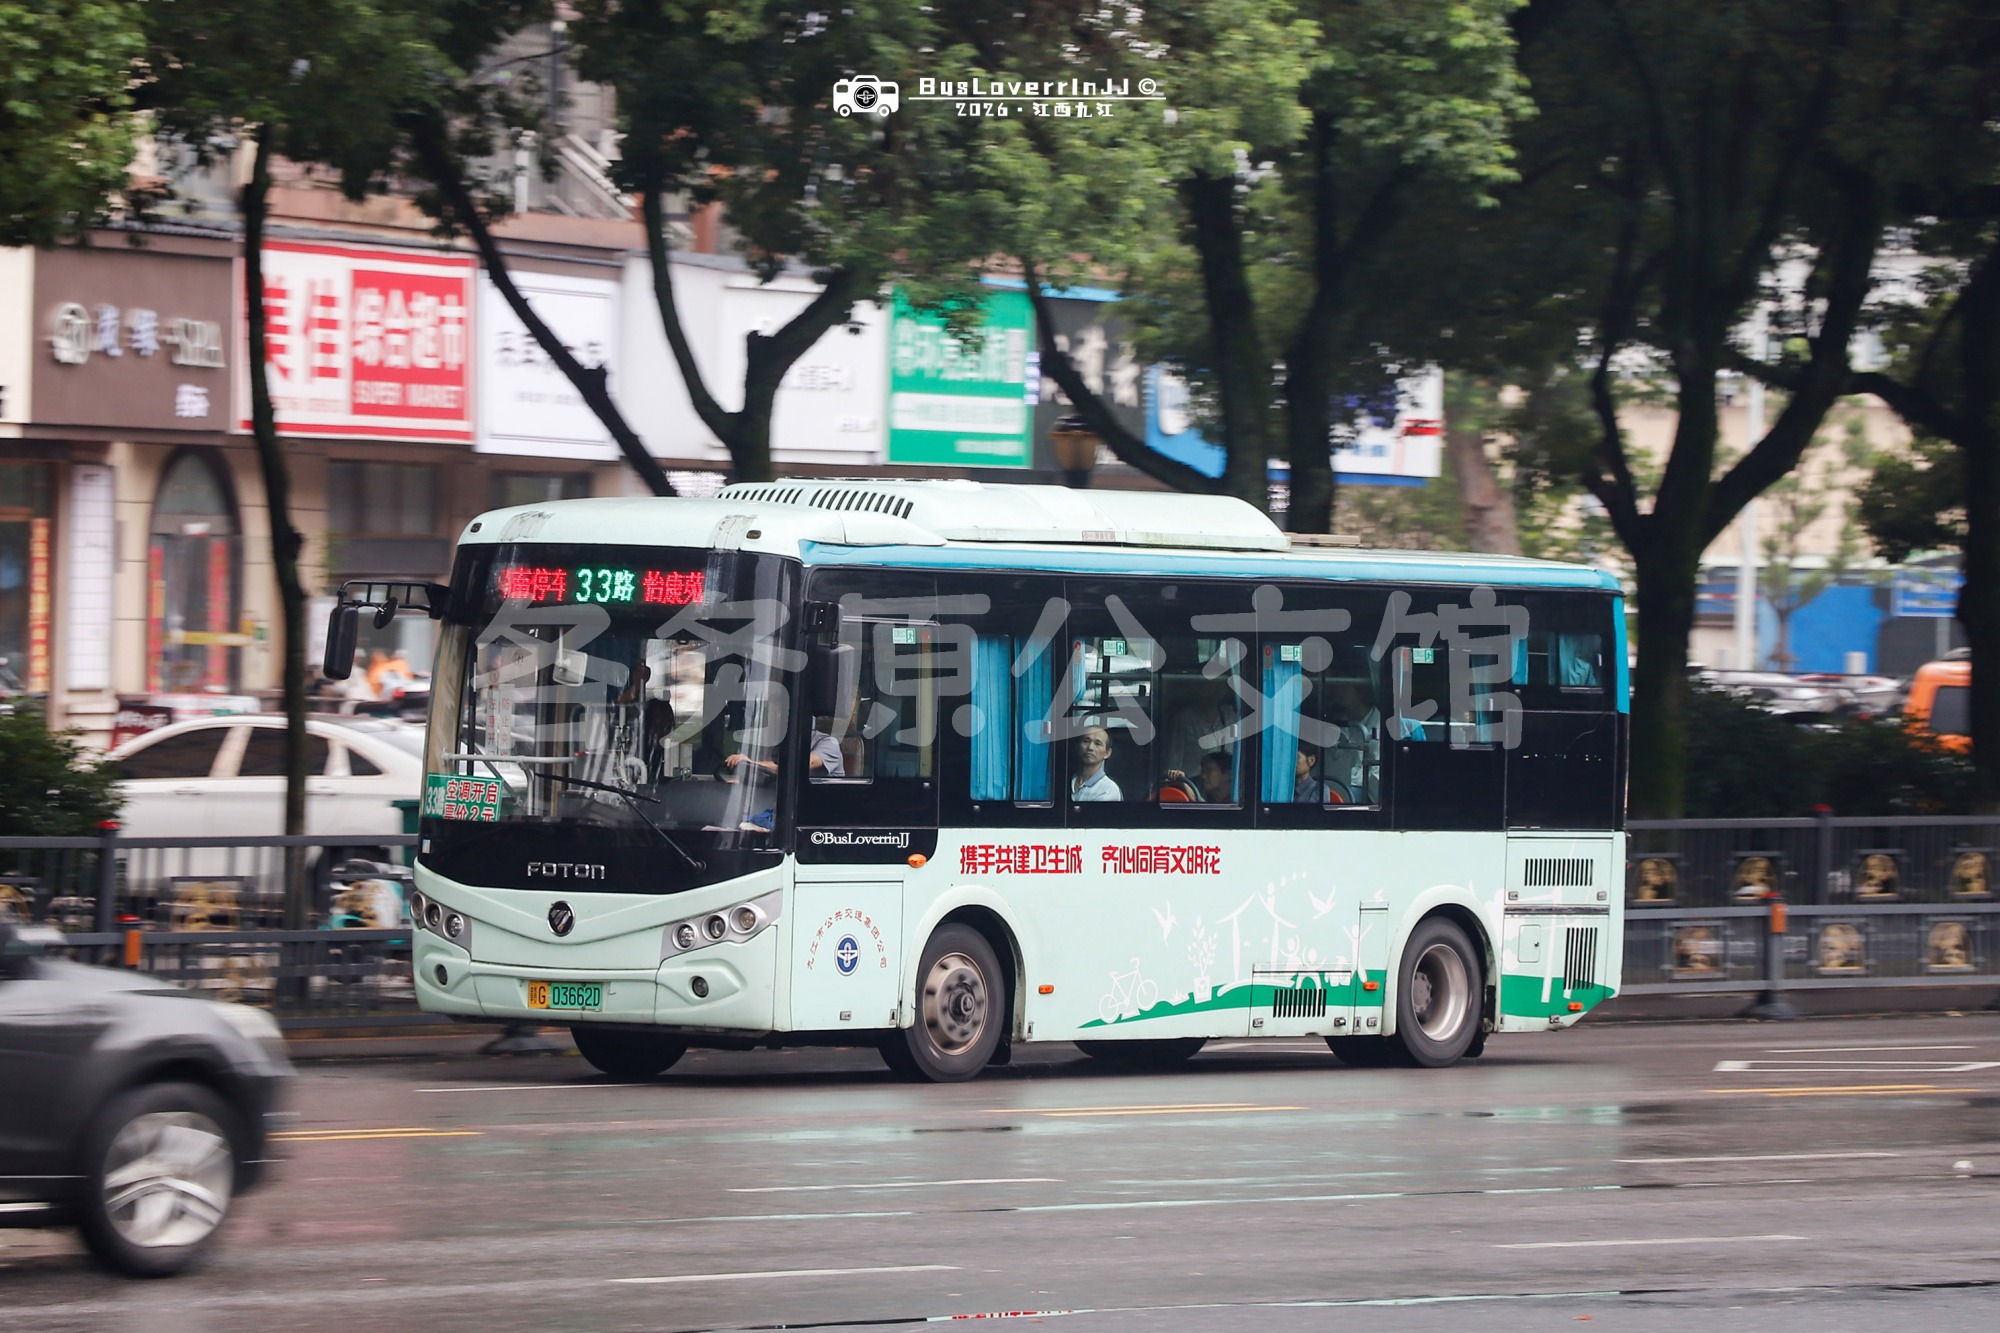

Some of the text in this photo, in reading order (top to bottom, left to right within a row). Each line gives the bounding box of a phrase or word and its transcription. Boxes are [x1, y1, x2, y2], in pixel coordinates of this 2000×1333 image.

[354, 286, 465, 371] 综合超市
[576, 569, 635, 602] 33路
[643, 570, 706, 604] 怡康苑
[446, 779, 499, 805] 空调开启
[443, 803, 495, 822] 票价2元
[960, 844, 1221, 875] 携手共建卫生城 齐心同育文明花
[552, 986, 601, 1006] 03662D
